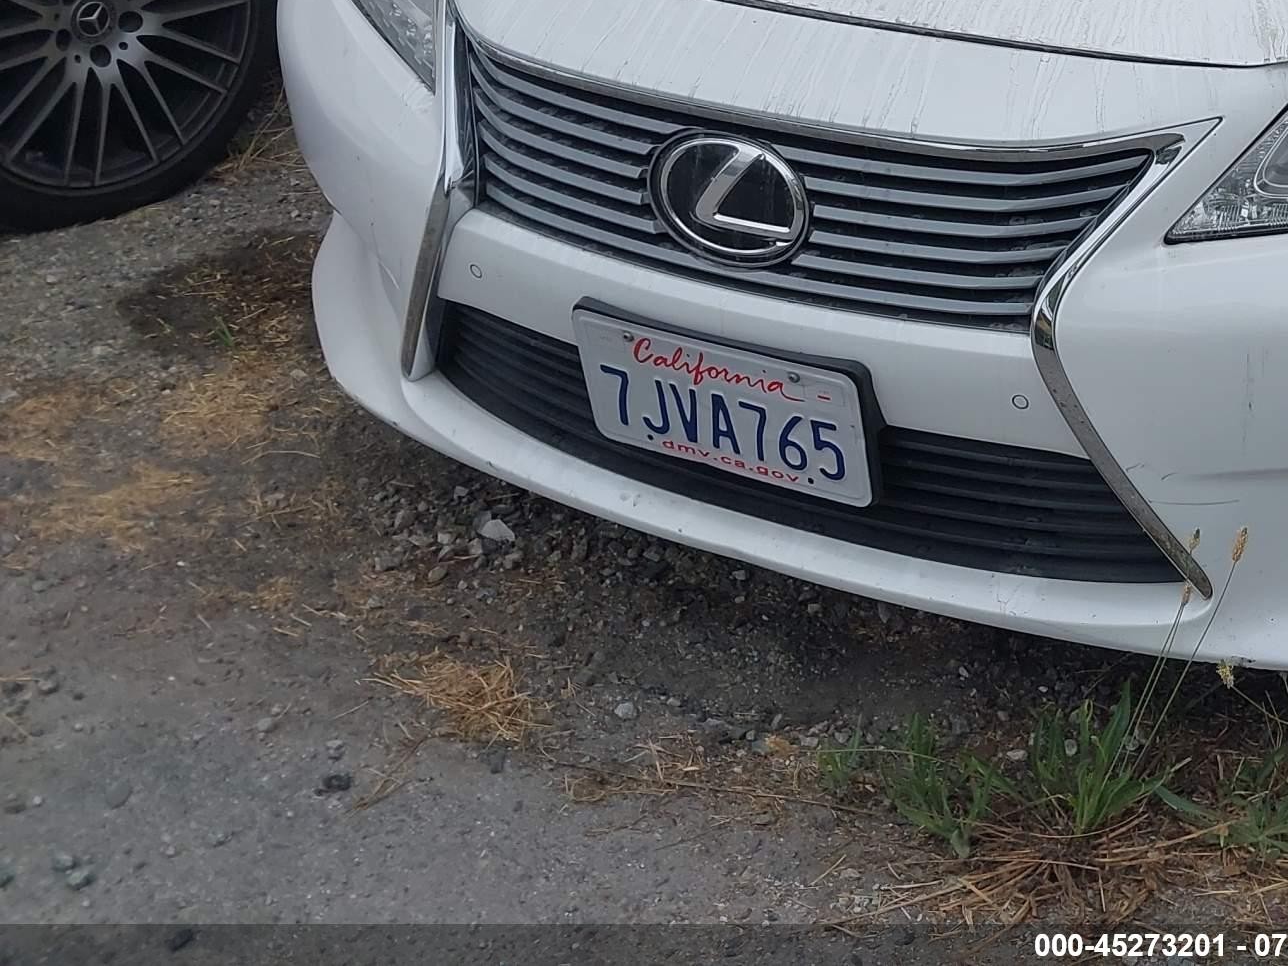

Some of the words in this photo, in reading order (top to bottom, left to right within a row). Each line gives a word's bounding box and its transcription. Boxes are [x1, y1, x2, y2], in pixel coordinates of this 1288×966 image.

[632, 337, 805, 403] California
[599, 364, 847, 482] 7JVA765
[661, 438, 802, 485] dmv.ca.gov
